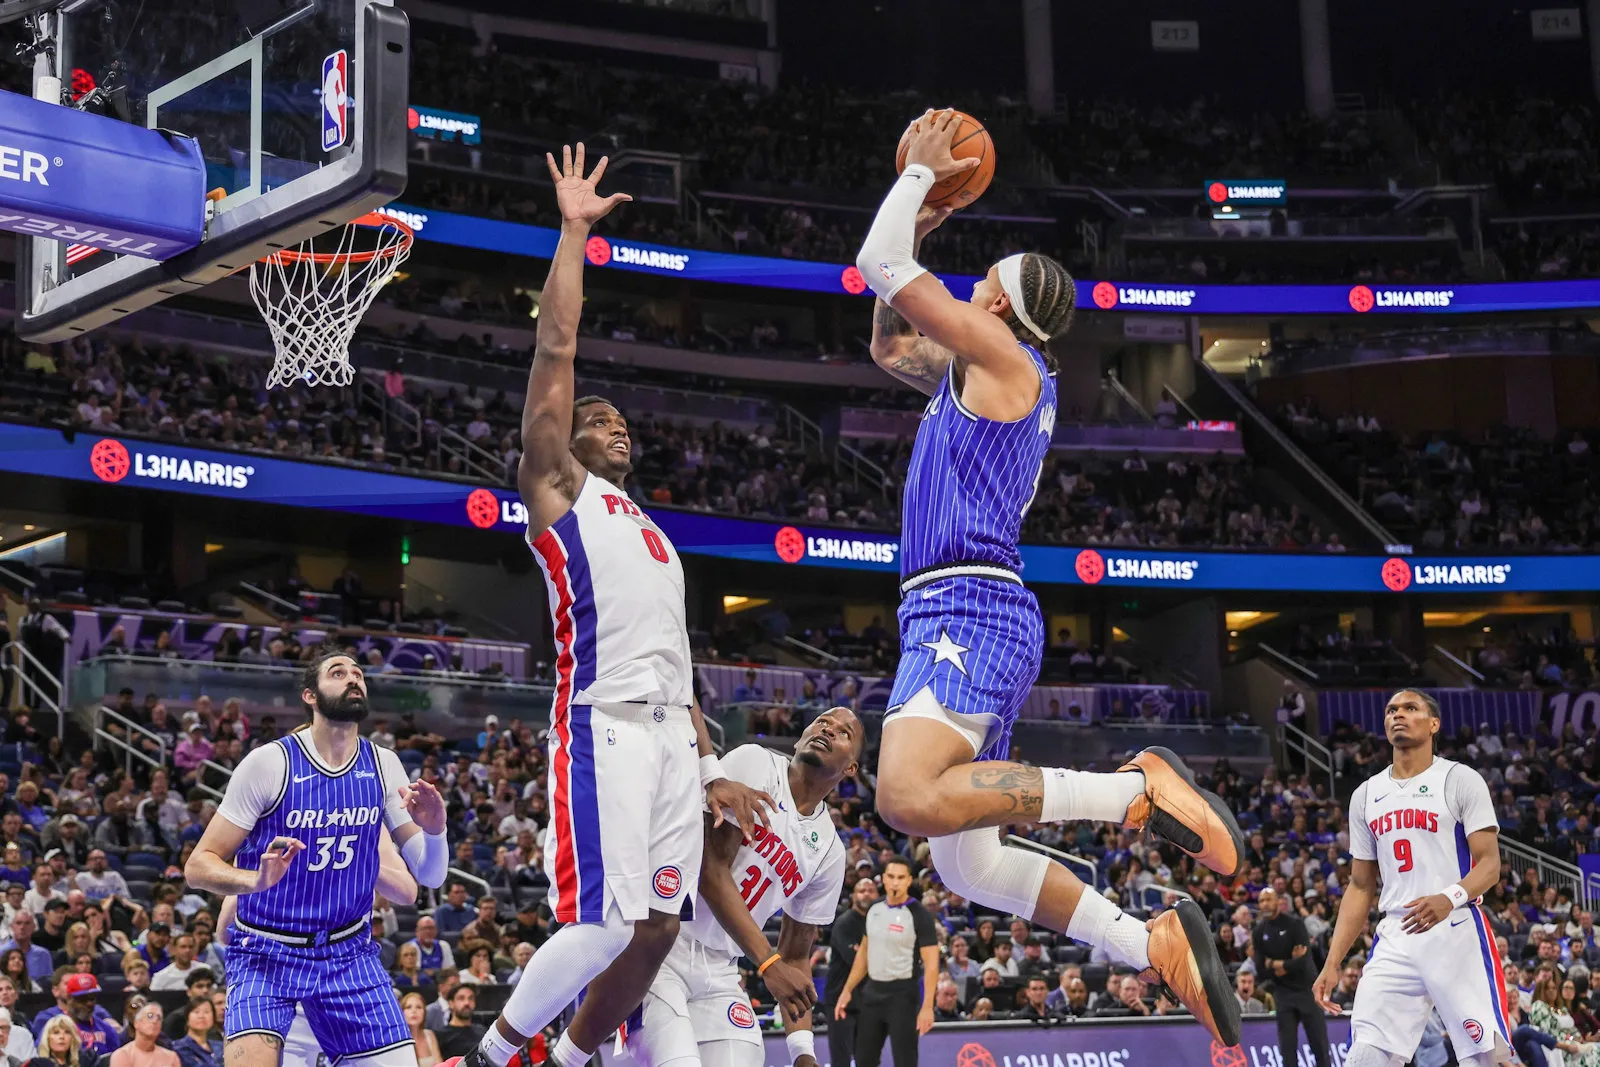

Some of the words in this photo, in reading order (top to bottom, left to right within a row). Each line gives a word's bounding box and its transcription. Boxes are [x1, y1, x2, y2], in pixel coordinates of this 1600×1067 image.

[612, 245, 687, 271] L3HARRIS
[1119, 288, 1193, 306] L3HARRIS
[1376, 290, 1452, 307] L3HARRIS
[134, 452, 252, 489] L3HARRIS
[641, 528, 669, 564] 0
[807, 536, 896, 563] L3HARRIS
[1107, 558, 1196, 580] L3HARRIS
[1414, 564, 1508, 584] L3HARRIS
[1369, 808, 1439, 841] PISTONS
[308, 834, 358, 872] 35
[1393, 838, 1413, 873] 9
[740, 864, 773, 912] 31
